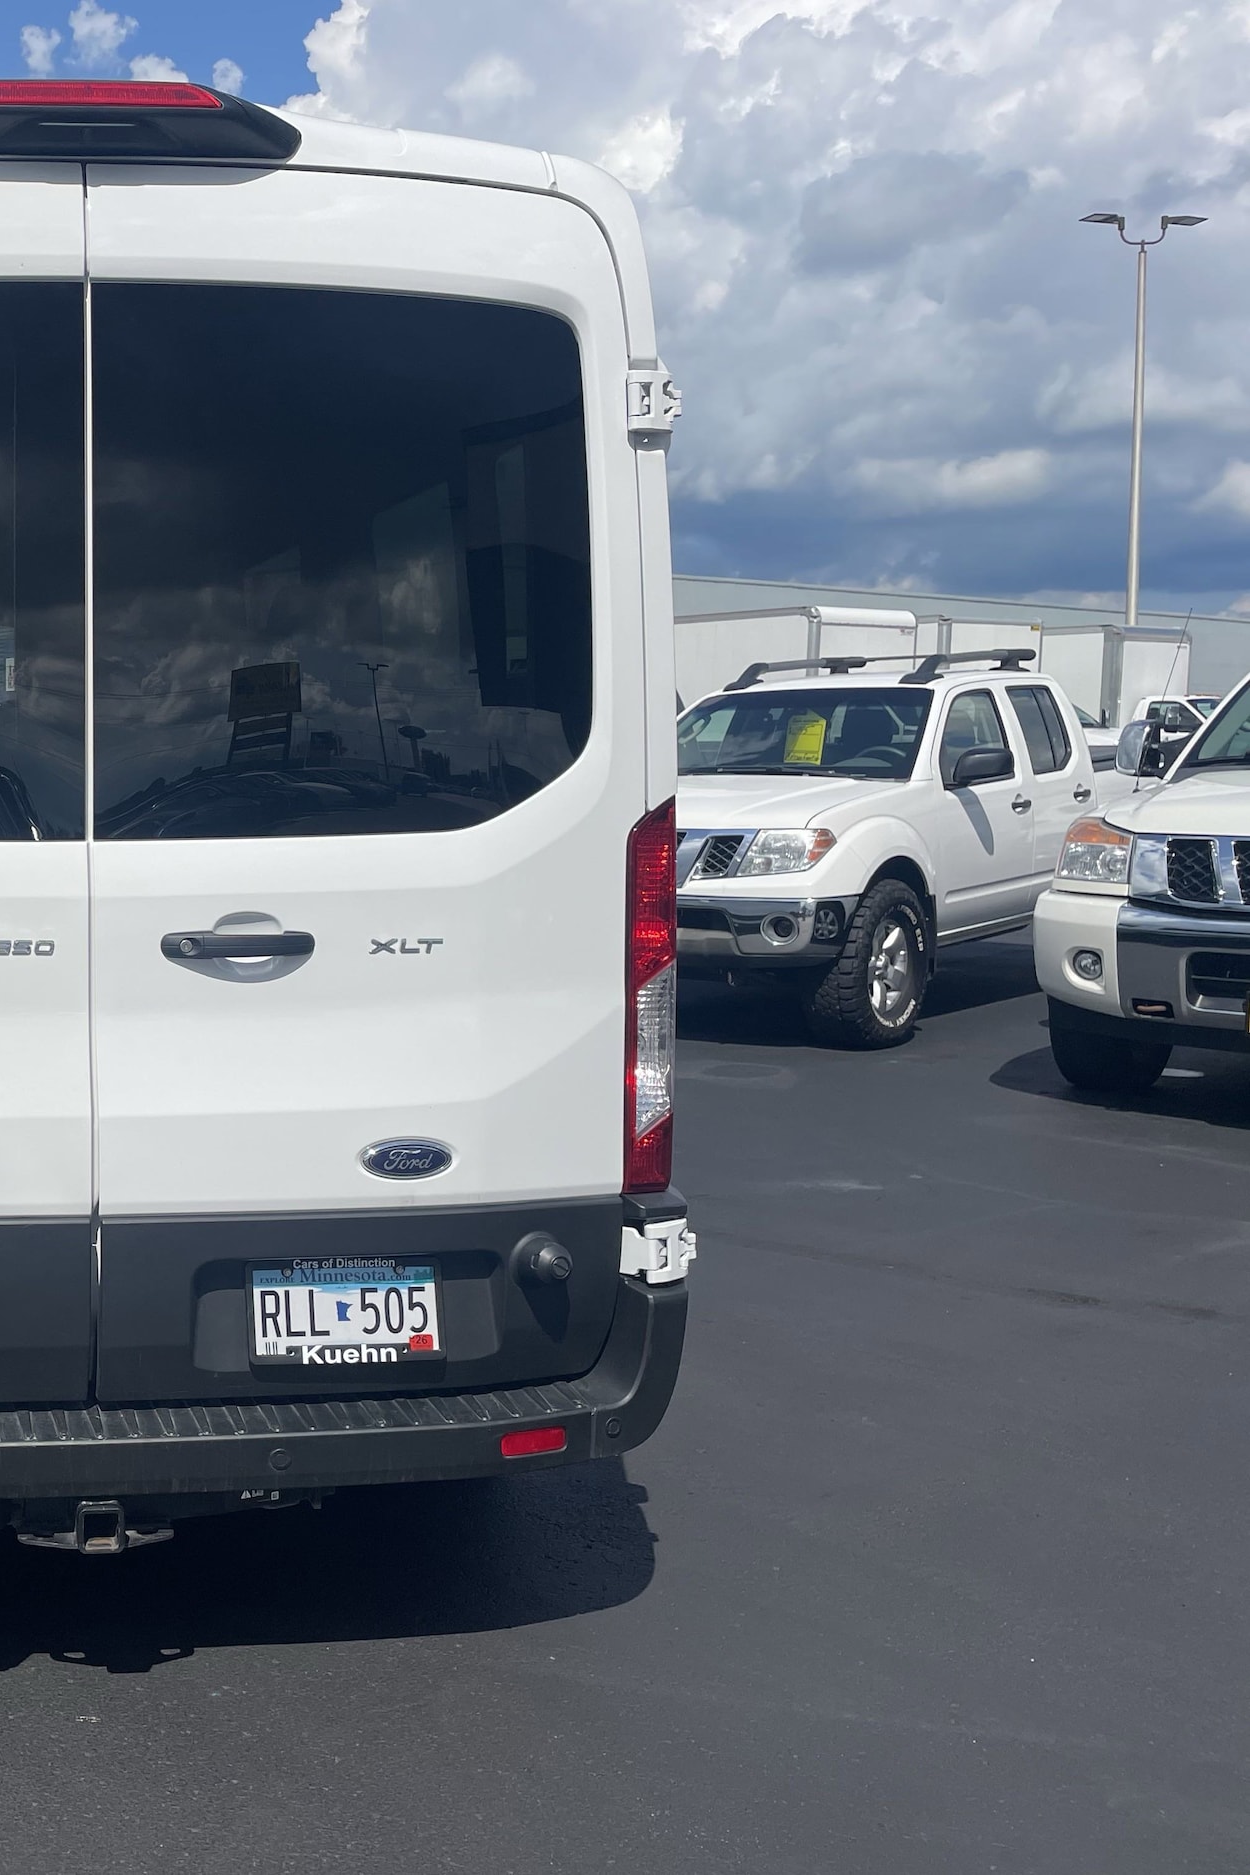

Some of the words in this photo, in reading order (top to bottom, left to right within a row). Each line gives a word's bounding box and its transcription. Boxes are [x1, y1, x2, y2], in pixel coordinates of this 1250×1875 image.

[369, 937, 444, 955] XLT
[383, 1149, 433, 1171] Ford
[292, 1259, 319, 1269] Cars
[321, 1258, 335, 1268] of
[336, 1257, 396, 1268] Distinction
[260, 1289, 331, 1339] RLL
[360, 1286, 429, 1335] 505
[416, 1336, 428, 1345] 26
[301, 1344, 398, 1366] Kuehn
